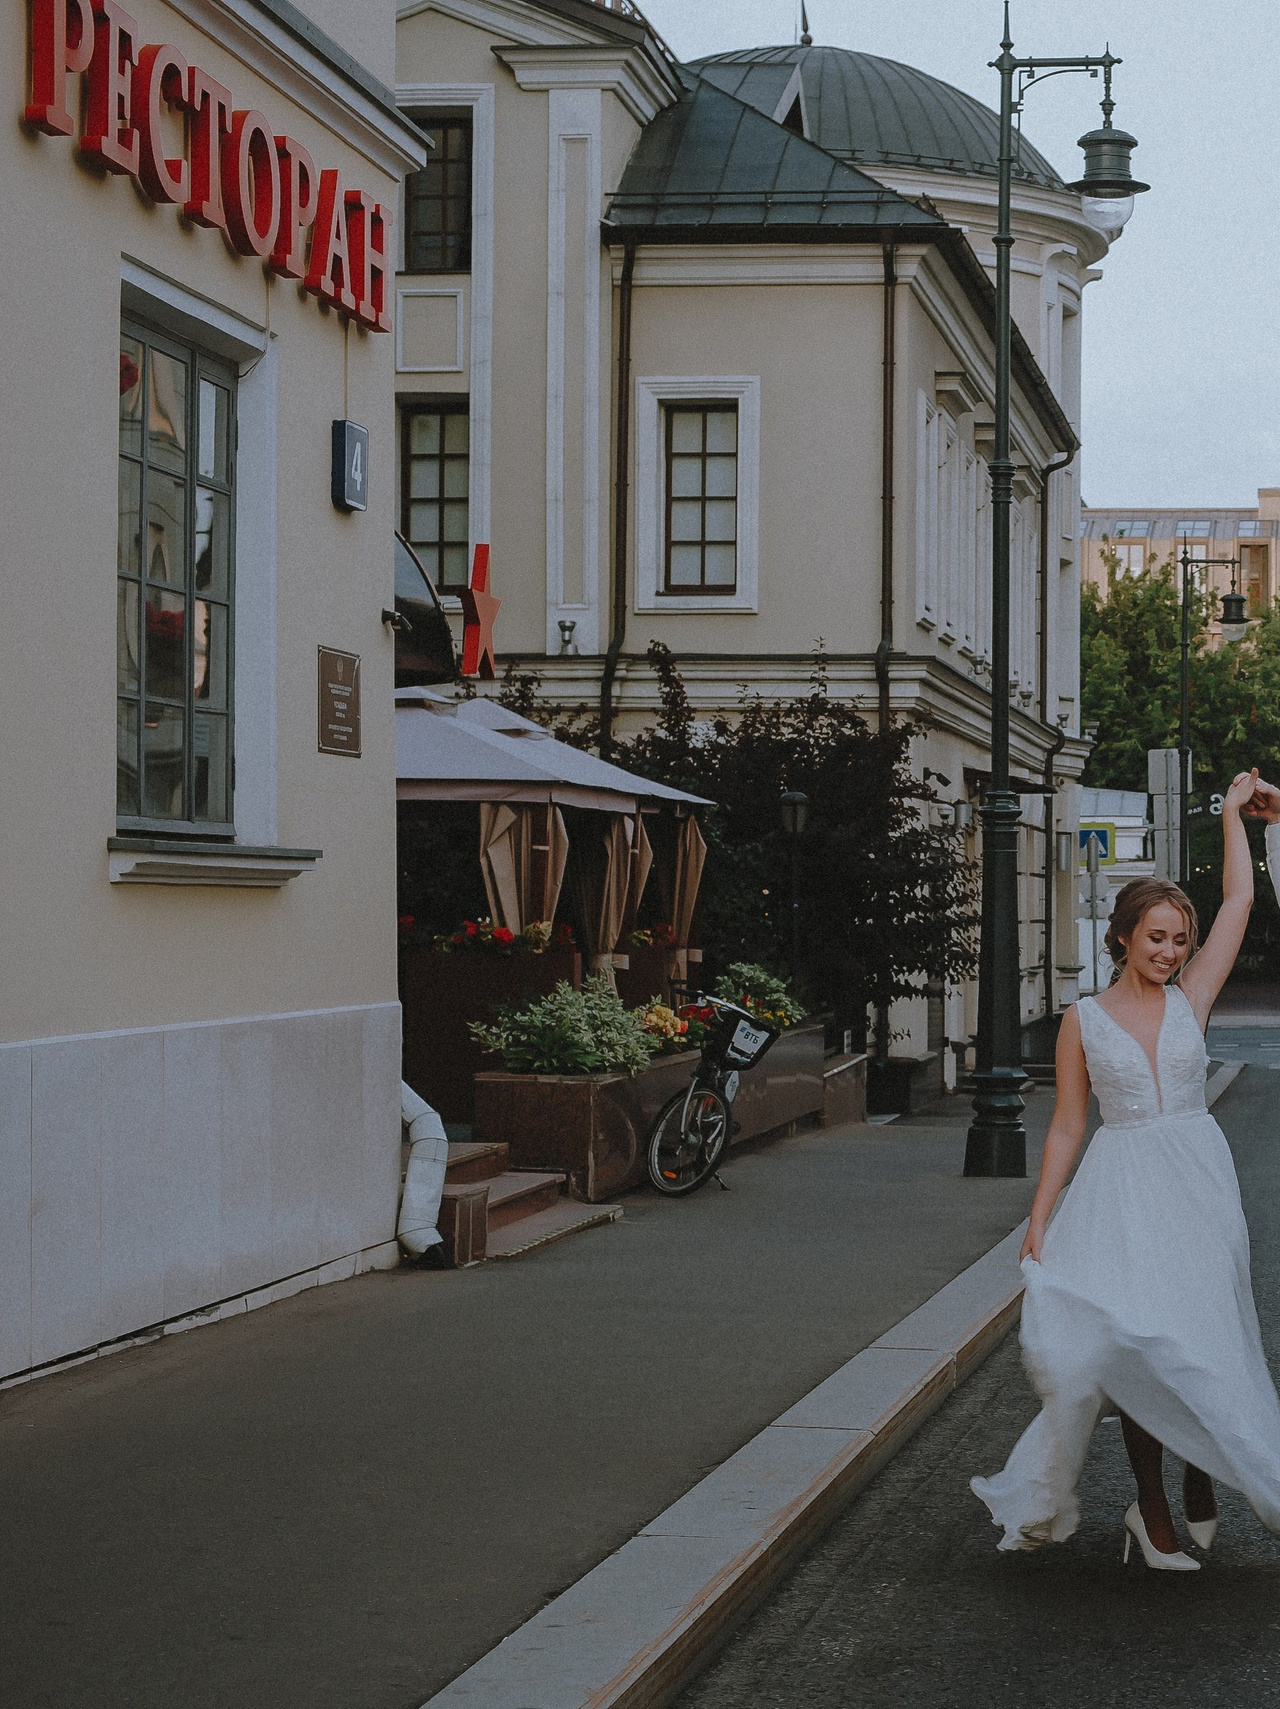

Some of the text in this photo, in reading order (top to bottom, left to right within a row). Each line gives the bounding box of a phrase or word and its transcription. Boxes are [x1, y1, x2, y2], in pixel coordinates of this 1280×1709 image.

[25, 0, 394, 333] РЕСТОРАН
[350, 441, 363, 492] 4
[744, 1031, 759, 1044] ВТБ
